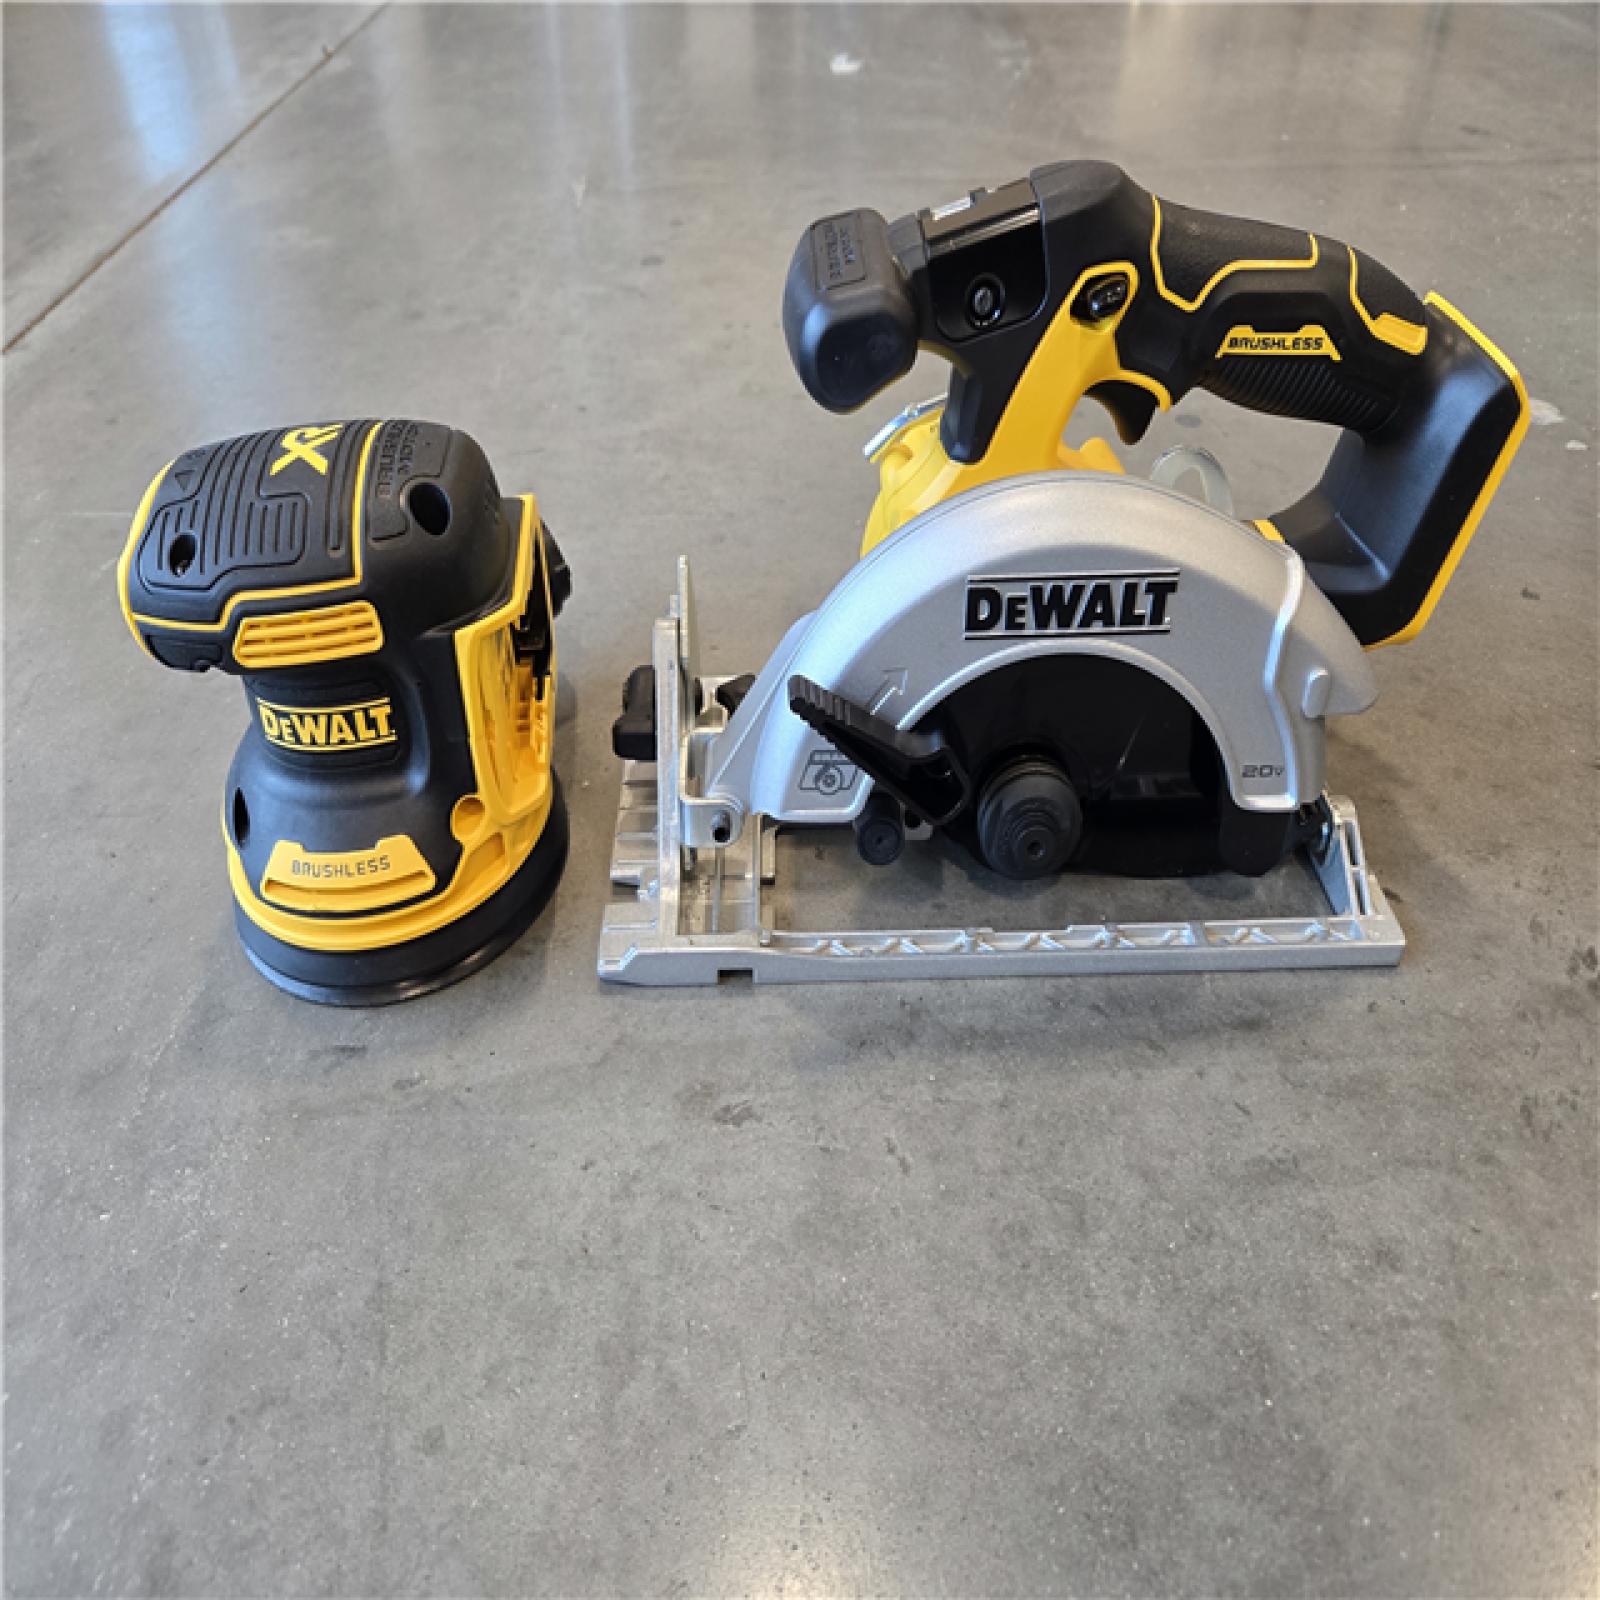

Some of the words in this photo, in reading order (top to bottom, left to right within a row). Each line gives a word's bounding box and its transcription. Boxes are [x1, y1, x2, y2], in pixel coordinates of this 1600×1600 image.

[1228, 337, 1324, 350] BRUSHLESS
[965, 580, 1178, 632] DEWALT
[259, 704, 391, 744] DEWALT
[292, 855, 391, 878] BRUSHLESS
